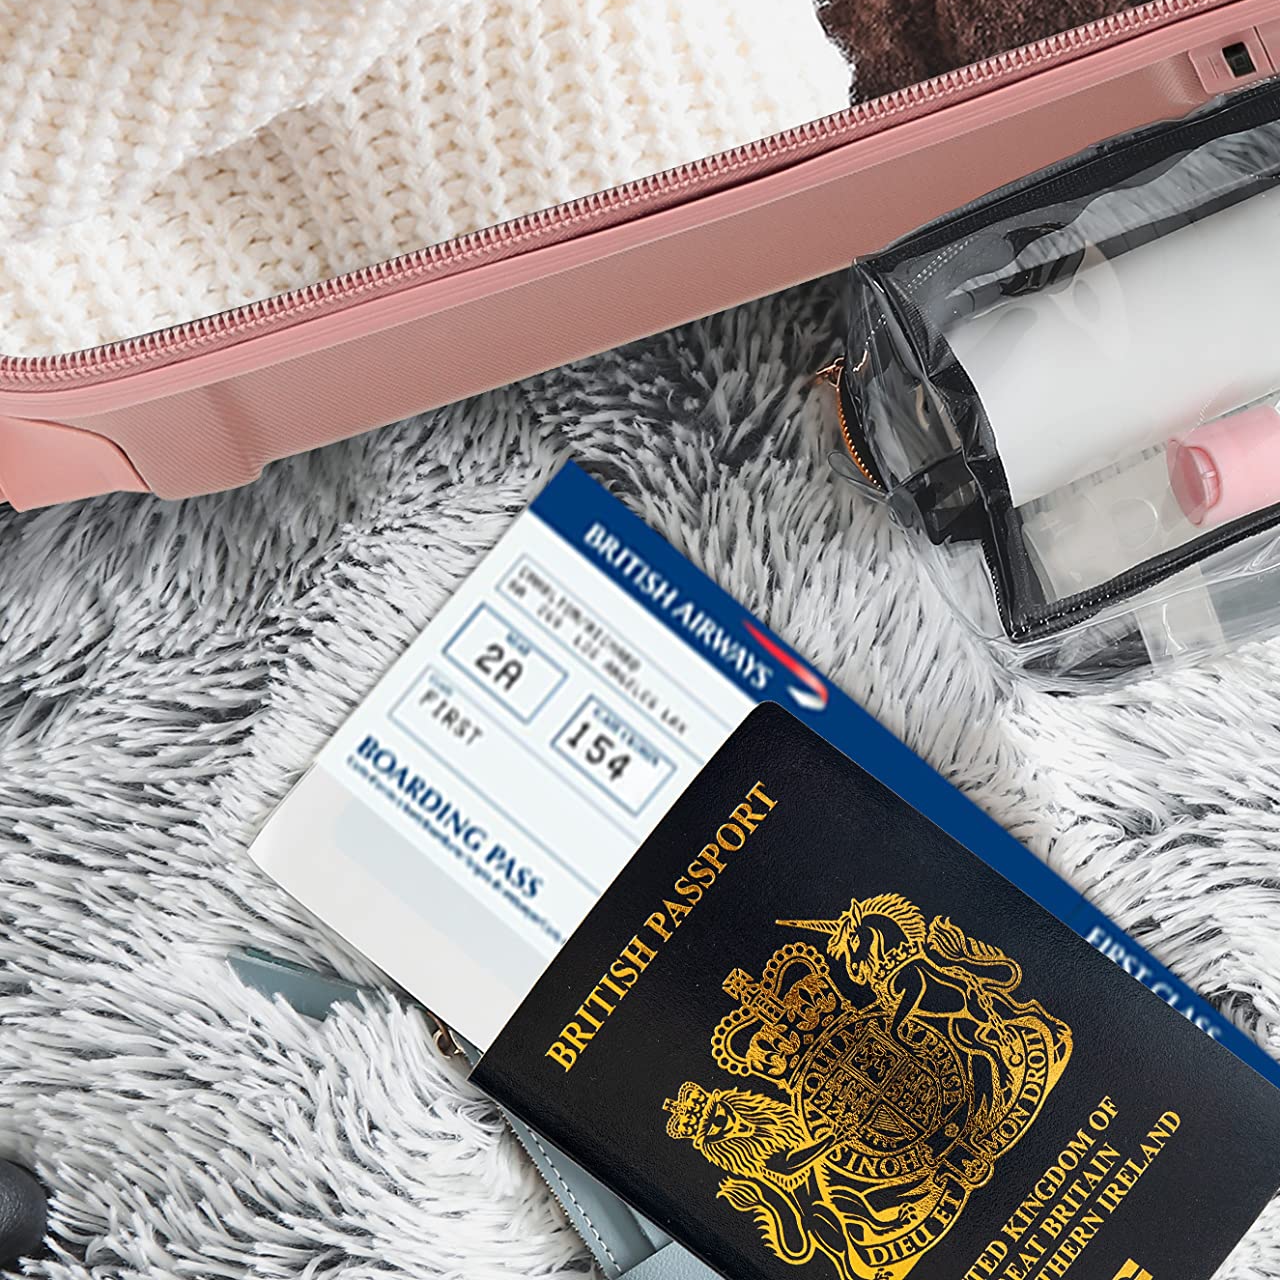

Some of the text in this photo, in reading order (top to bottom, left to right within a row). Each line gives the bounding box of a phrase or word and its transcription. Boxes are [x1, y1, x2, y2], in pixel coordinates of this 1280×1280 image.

[474, 643, 523, 692] 2A
[584, 522, 774, 690] BRITISH AIRWAYS
[418, 688, 484, 747] FIRST
[567, 721, 631, 782] 154
[356, 734, 488, 853] BOARDING
[485, 843, 544, 899] PASS
[545, 780, 778, 1072] BRITISH PASSPORT
[865, 1029, 1048, 1266] DIEU ET MON DROIT
[962, 1095, 1119, 1280] TED KINGDOM OF
[998, 1142, 1120, 1280] EAT BRITAIN
[1033, 1110, 1181, 1280] THERN IRELAND
